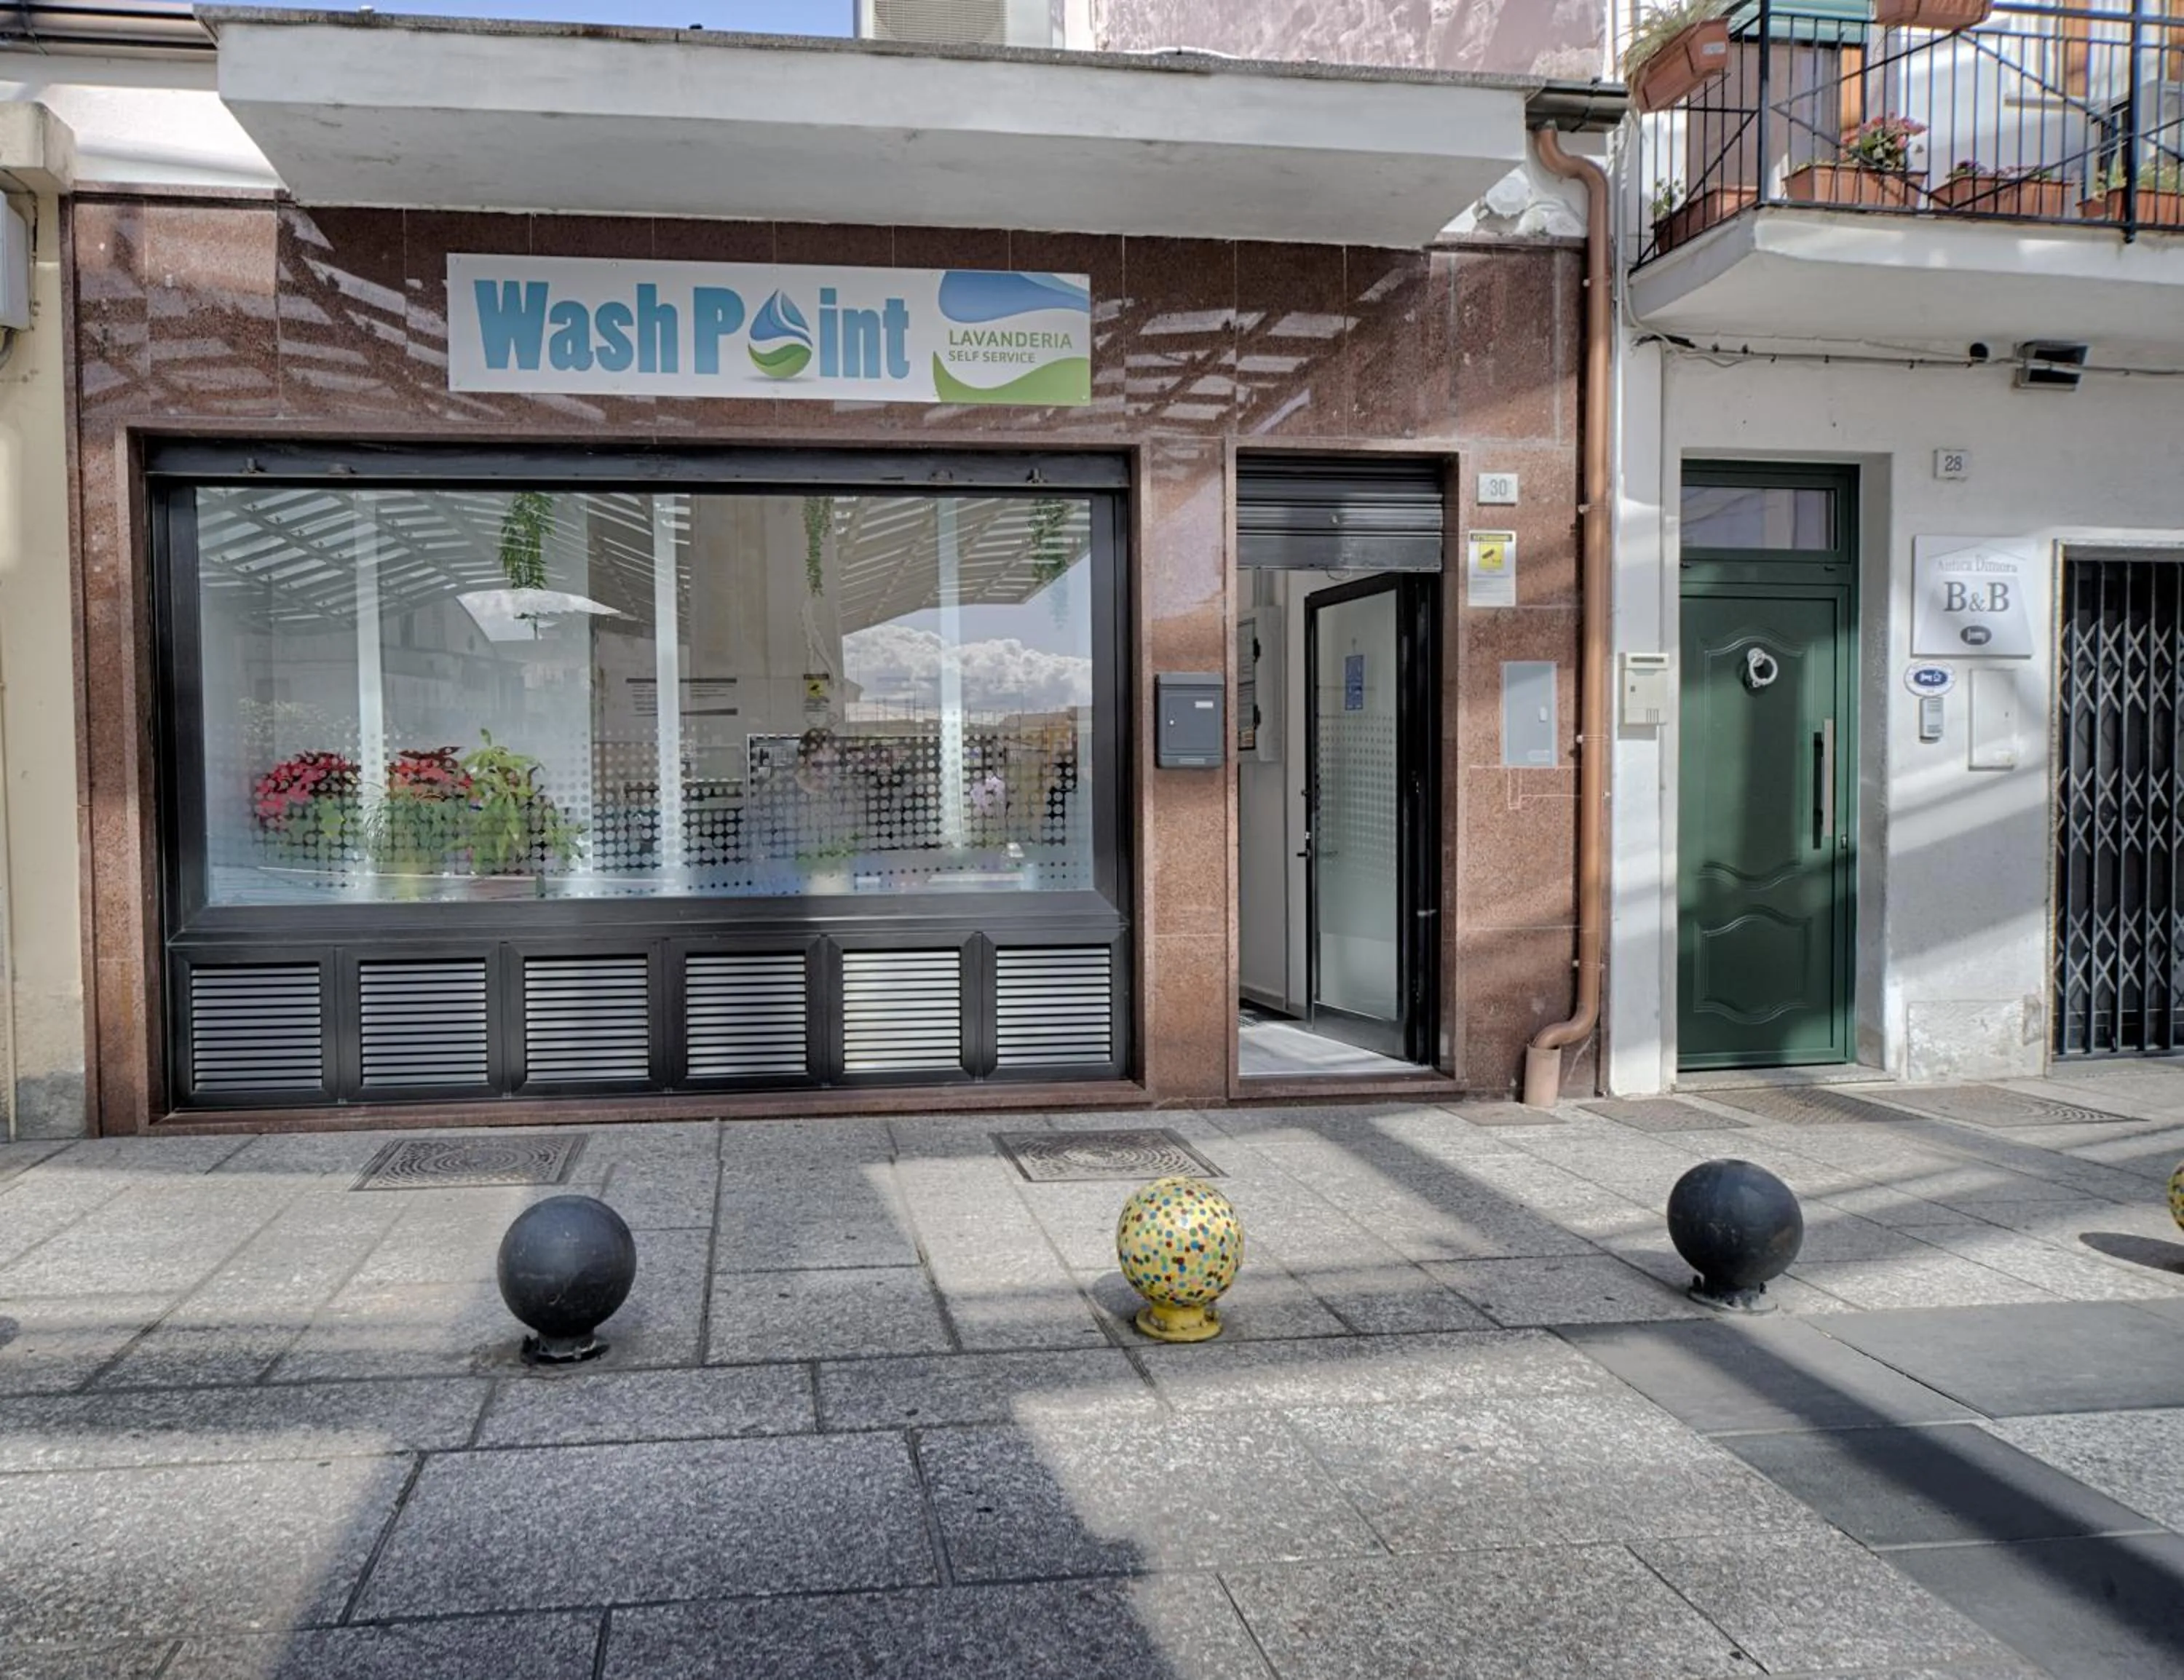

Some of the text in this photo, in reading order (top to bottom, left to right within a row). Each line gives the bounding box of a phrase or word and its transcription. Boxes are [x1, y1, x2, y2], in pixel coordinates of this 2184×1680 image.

[474, 280, 678, 373] Wash
[949, 329, 1072, 349] LAVANDERIA
[948, 350, 1036, 363] SELF SERVICE
[1944, 455, 1963, 472] 28
[1490, 479, 1508, 496] 30
[1943, 581, 2010, 612] B&B
